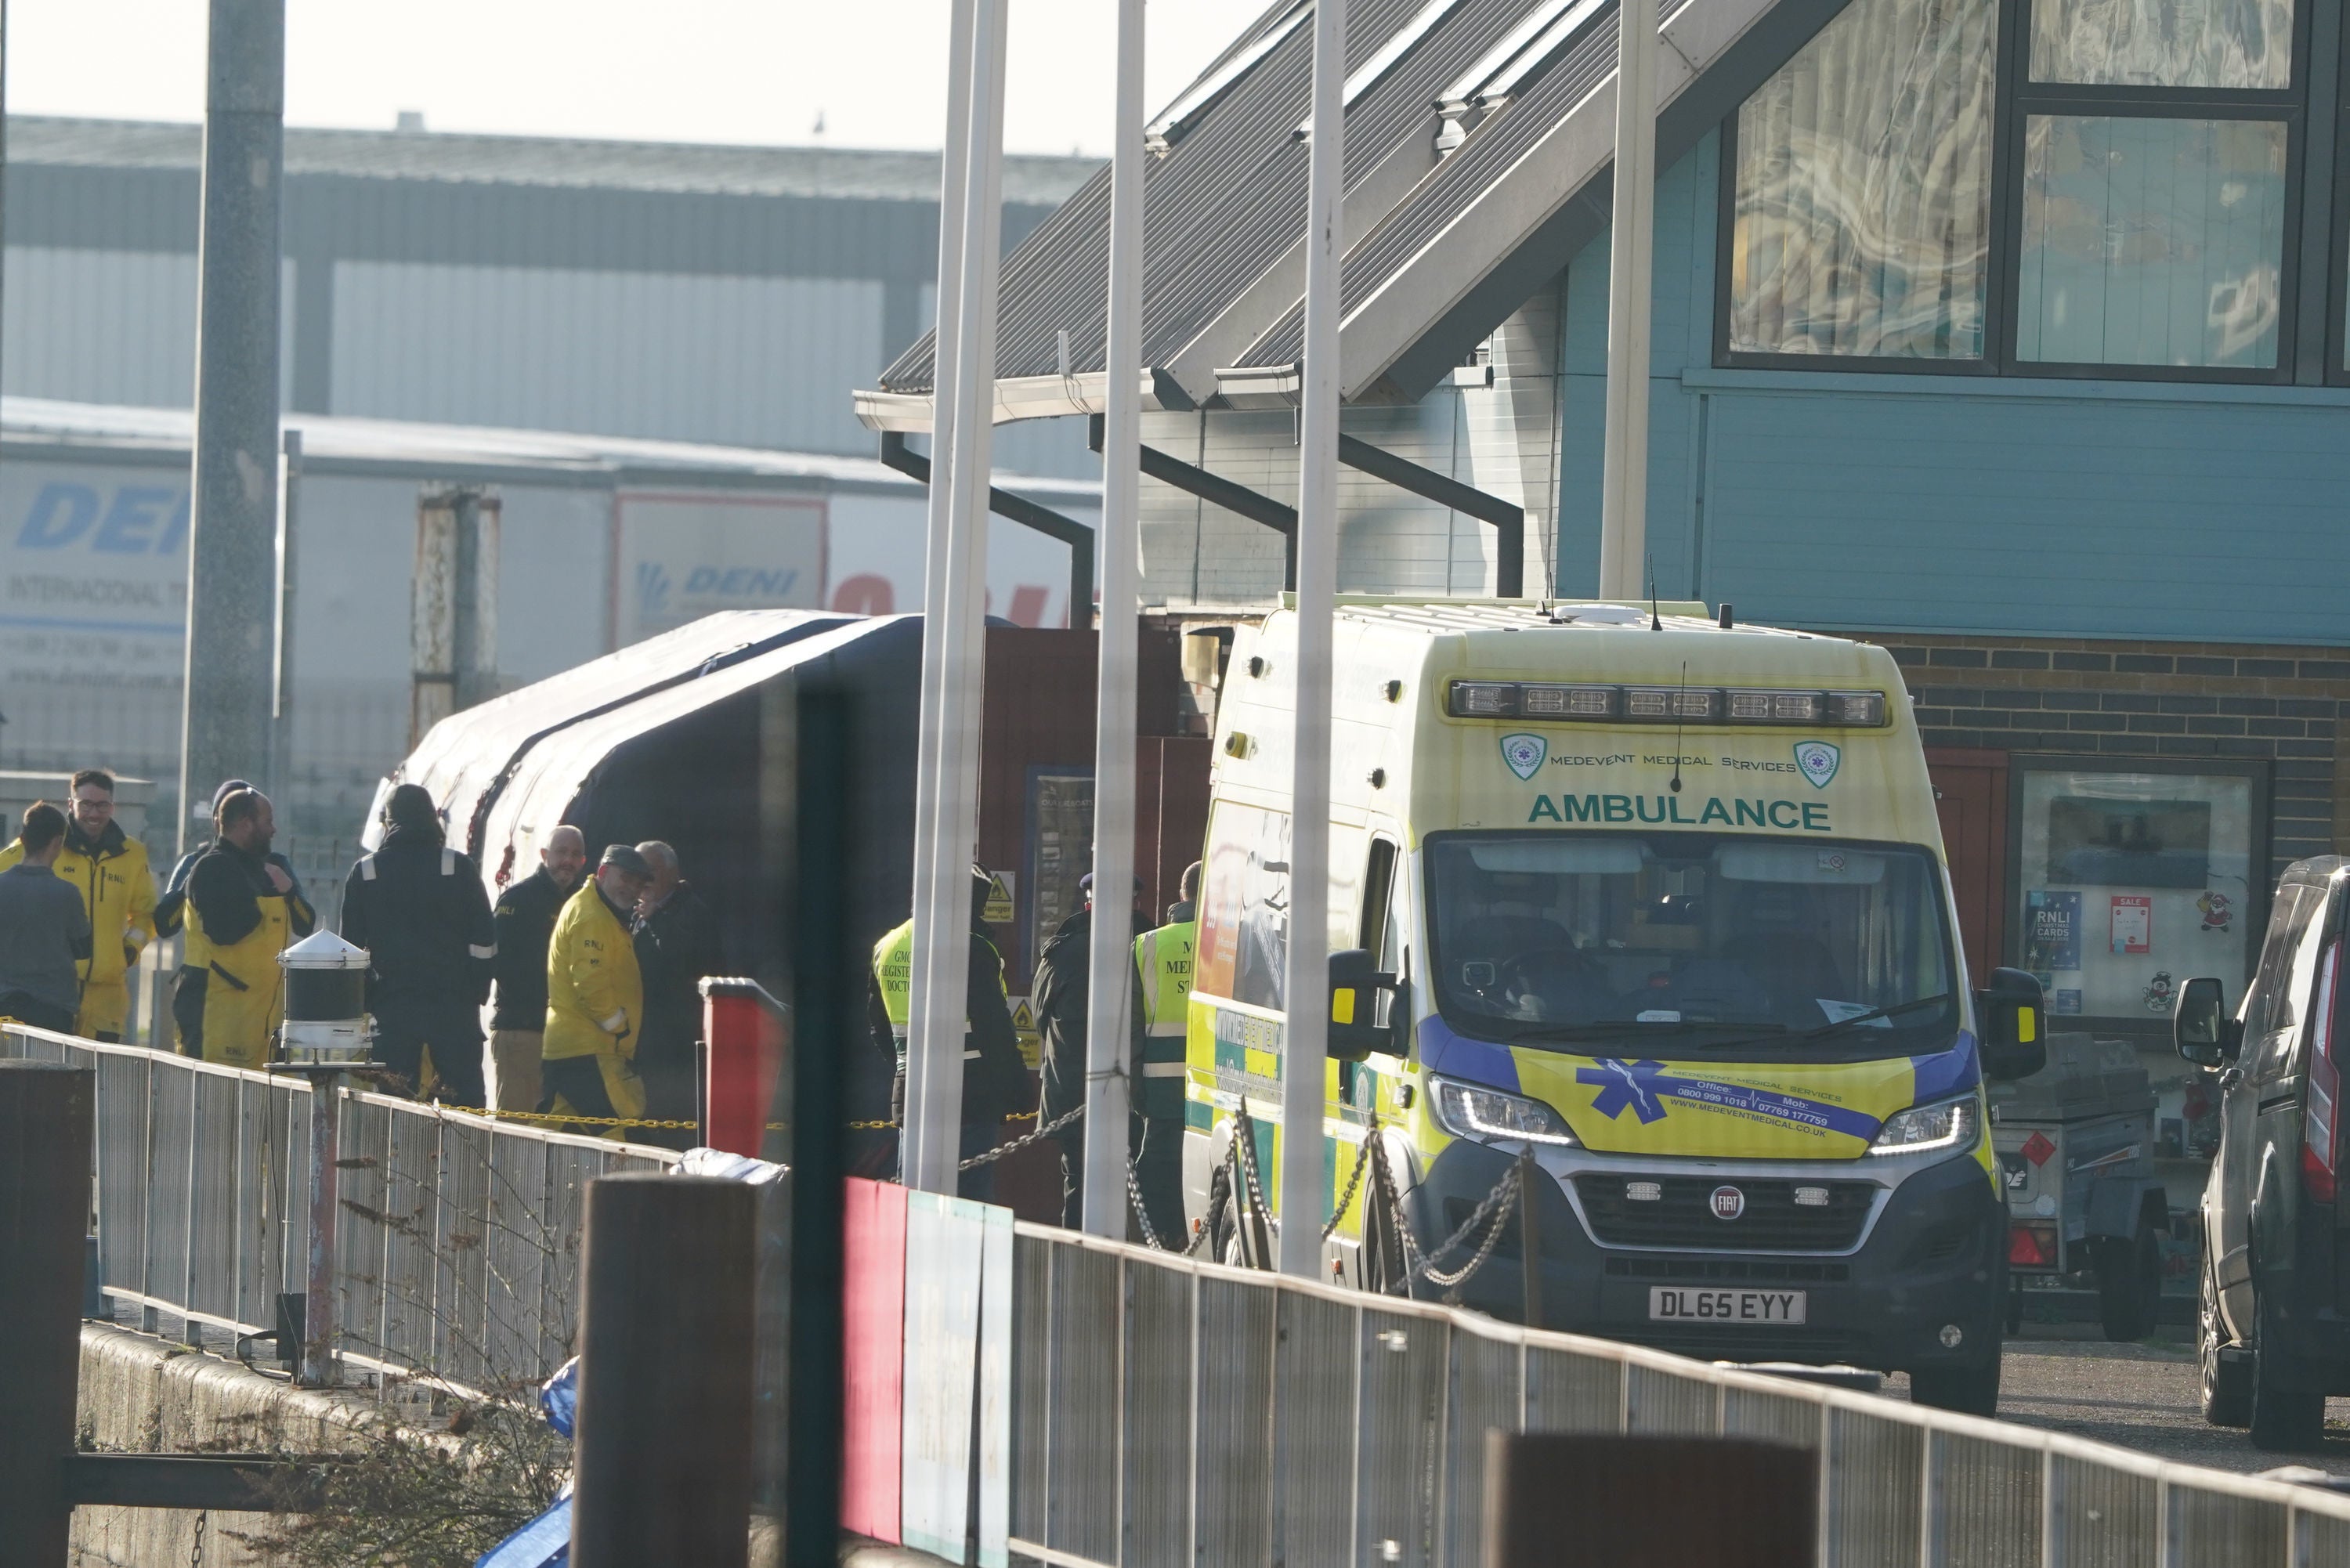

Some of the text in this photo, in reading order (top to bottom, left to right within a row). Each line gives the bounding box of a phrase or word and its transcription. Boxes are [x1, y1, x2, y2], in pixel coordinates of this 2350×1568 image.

[683, 563, 800, 596] DENI
[1550, 754, 1636, 766] MEDEVENT
[1643, 756, 1713, 765] MEDICAL
[1721, 757, 1796, 772] SERVICES
[1528, 794, 1831, 832] AMBULANCE
[2037, 911, 2070, 923] RNLI
[2037, 928, 2070, 937] CARDS
[584, 940, 604, 951] RNLI
[881, 965, 911, 977] REGISTE
[1672, 1071, 1842, 1102] MEDEVENT MEDICAL SERVICES
[1697, 1081, 1732, 1093] Office:
[1678, 1088, 1747, 1107] 0800 999 1018
[1782, 1097, 1809, 1109] Mob:
[1670, 1099, 1827, 1138] WWW.MEDEVENTMEDICAL.CO.UK
[1759, 1103, 1828, 1126] 07769 177759
[1719, 1195, 1737, 1211] FIAT
[1660, 1292, 1794, 1320] DL65 EYY
